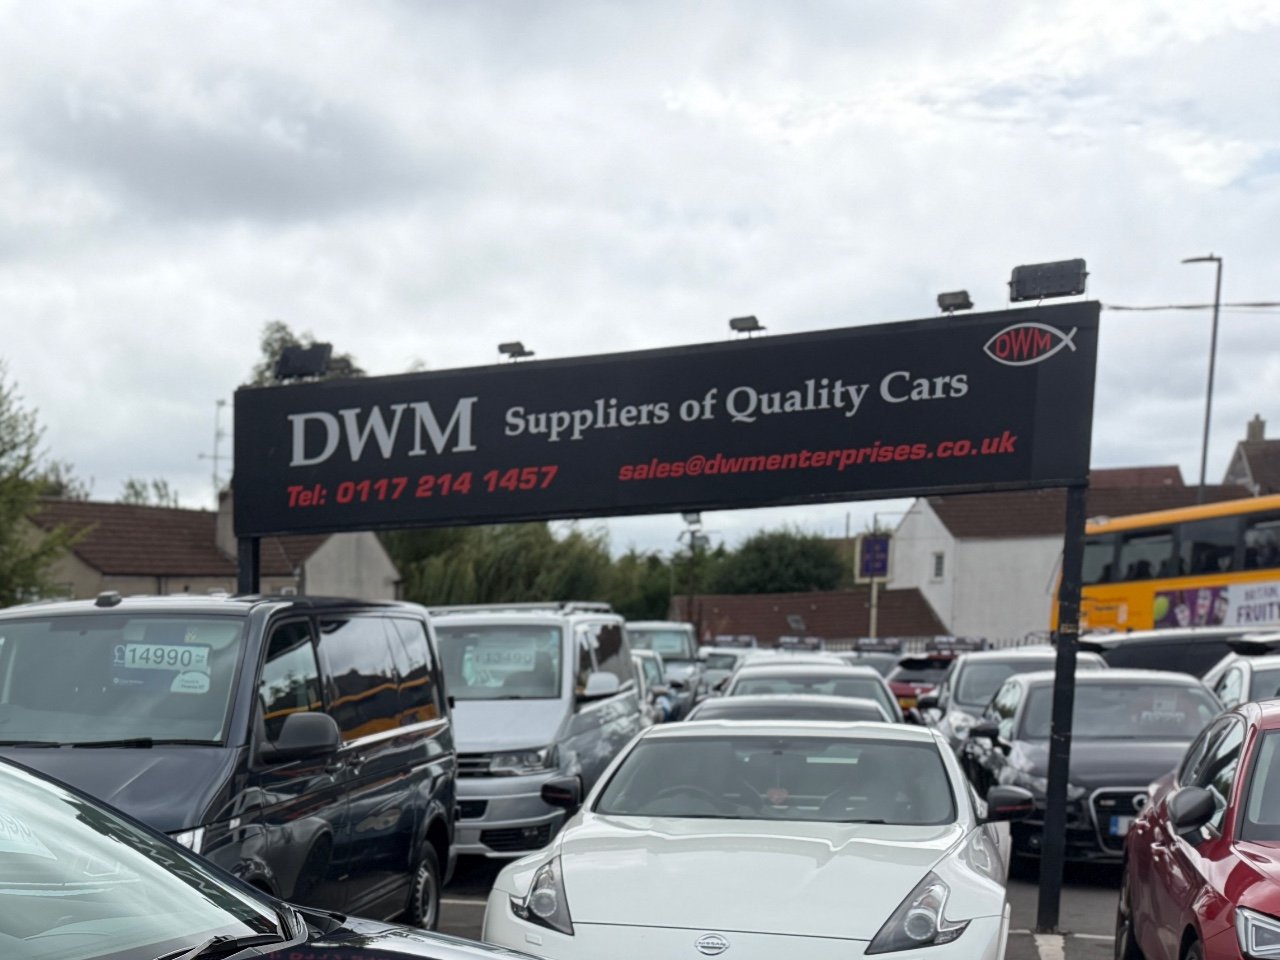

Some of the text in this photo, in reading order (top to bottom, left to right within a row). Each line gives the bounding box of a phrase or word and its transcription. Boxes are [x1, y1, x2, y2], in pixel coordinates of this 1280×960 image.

[287, 396, 478, 467] DWM
[504, 371, 969, 442] Suppliers of Quality Cars
[619, 430, 1017, 481] sales@dwmenterprises.co.uk
[287, 465, 559, 508] Tel: 0117 214 1457
